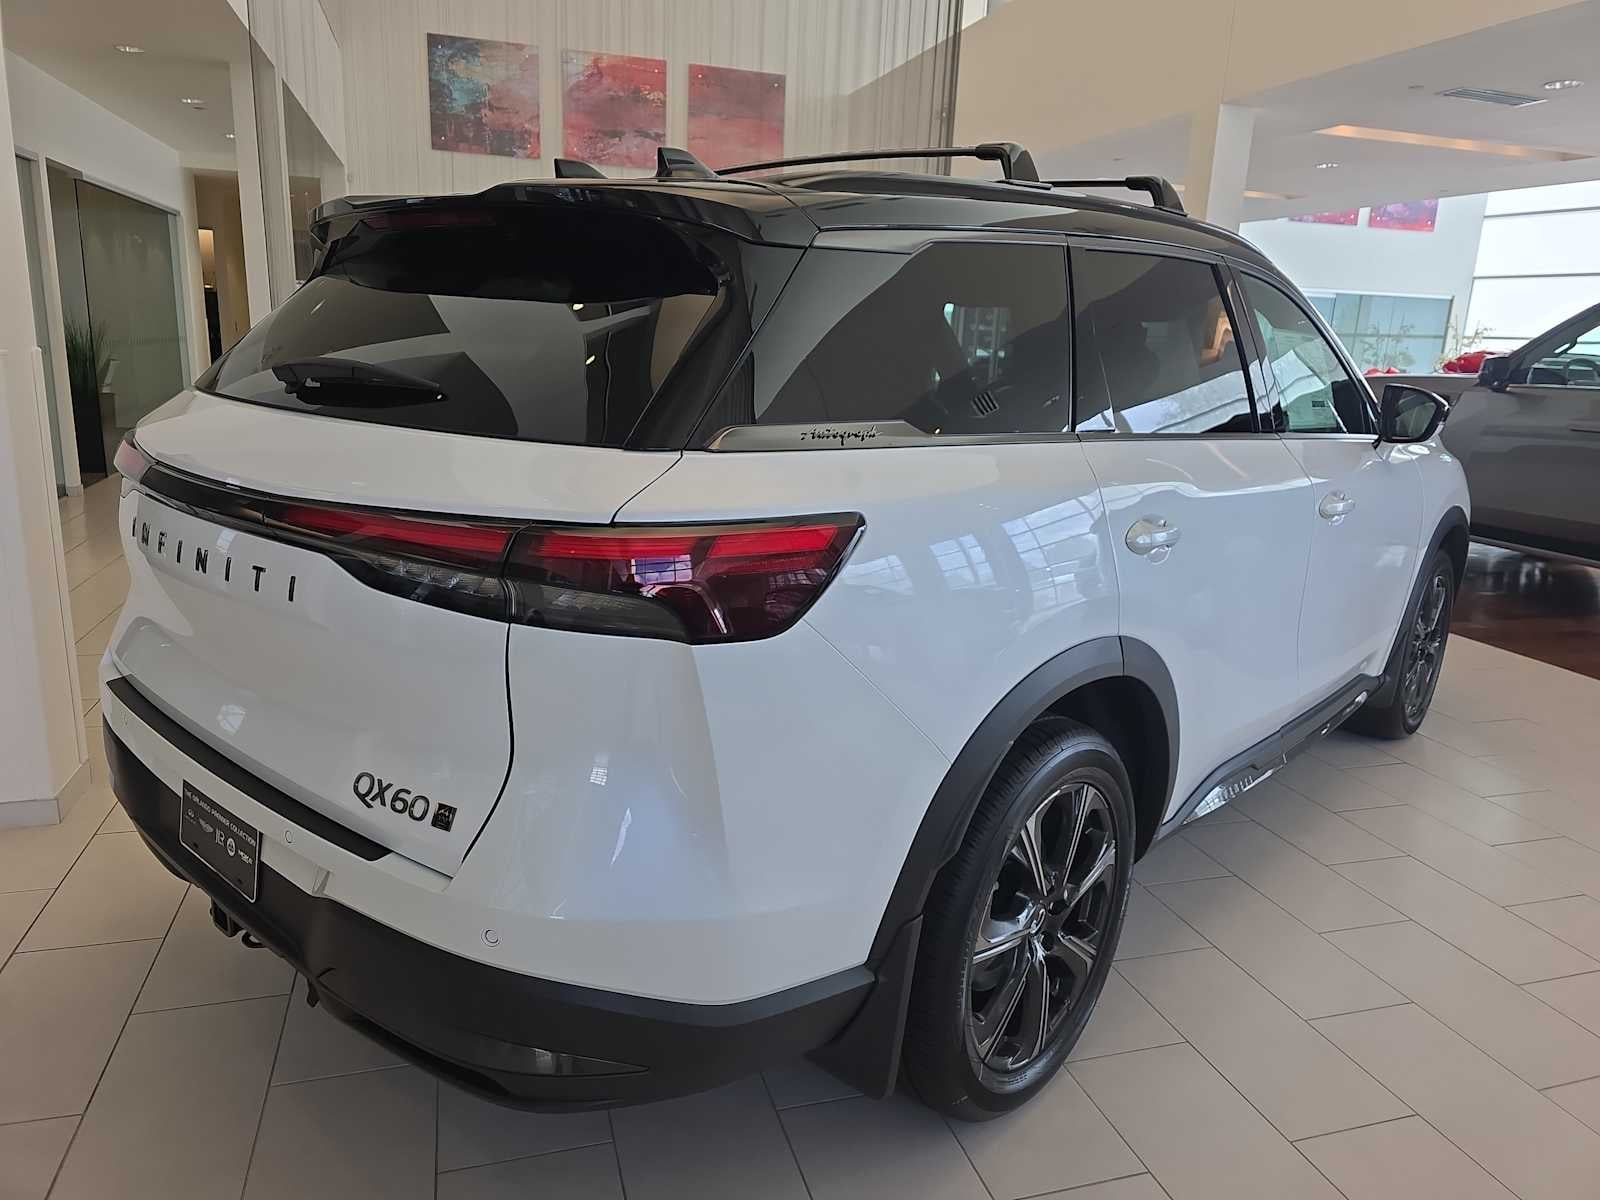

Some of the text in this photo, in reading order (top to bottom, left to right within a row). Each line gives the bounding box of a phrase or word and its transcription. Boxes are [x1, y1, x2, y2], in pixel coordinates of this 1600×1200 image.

[132, 516, 296, 602] INFINITI
[353, 772, 430, 822] QX60
[230, 823, 256, 847] COLLECTION
